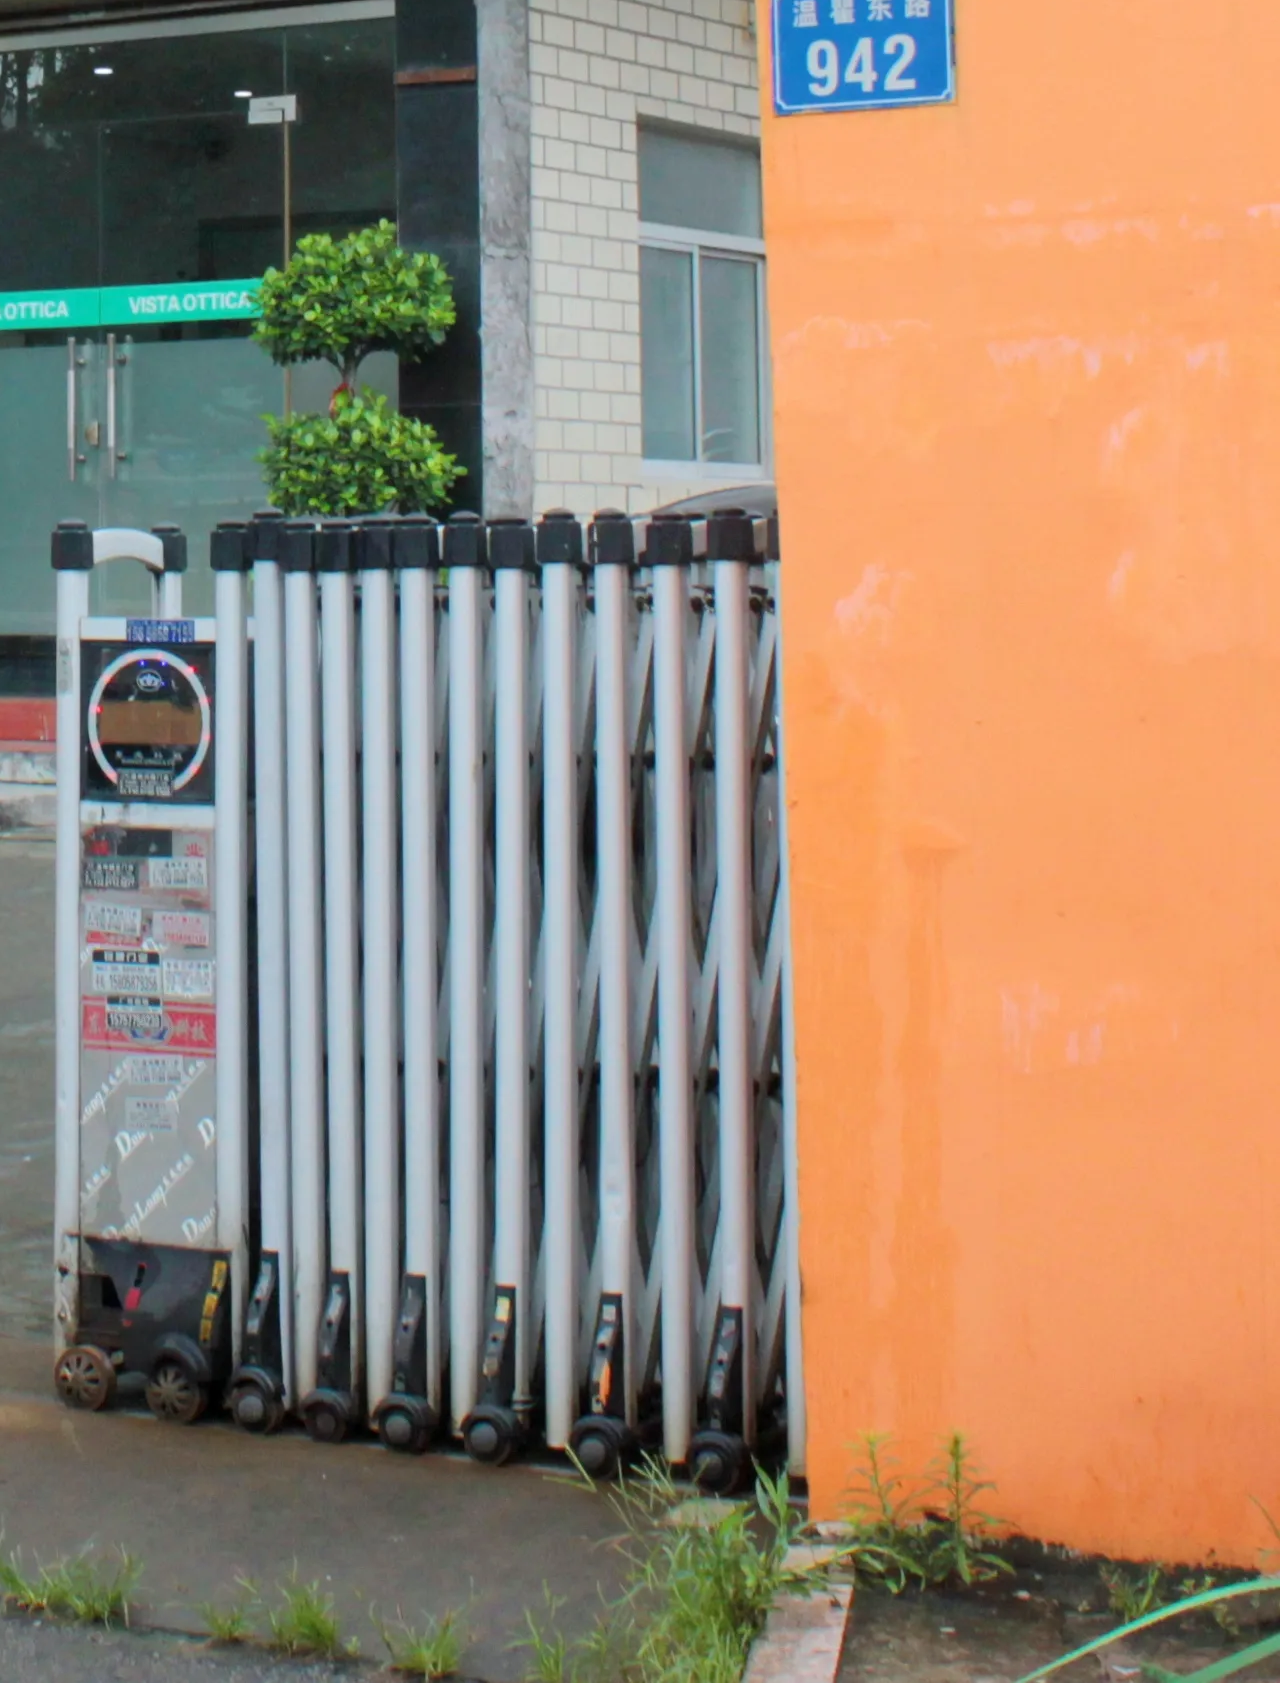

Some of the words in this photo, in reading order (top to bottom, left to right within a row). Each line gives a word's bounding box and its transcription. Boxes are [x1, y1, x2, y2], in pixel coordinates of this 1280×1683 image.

[806, 33, 917, 97] 942
[4, 300, 69, 320] OTTICA
[128, 295, 180, 314] VISTA
[183, 291, 252, 312] OTTICA
